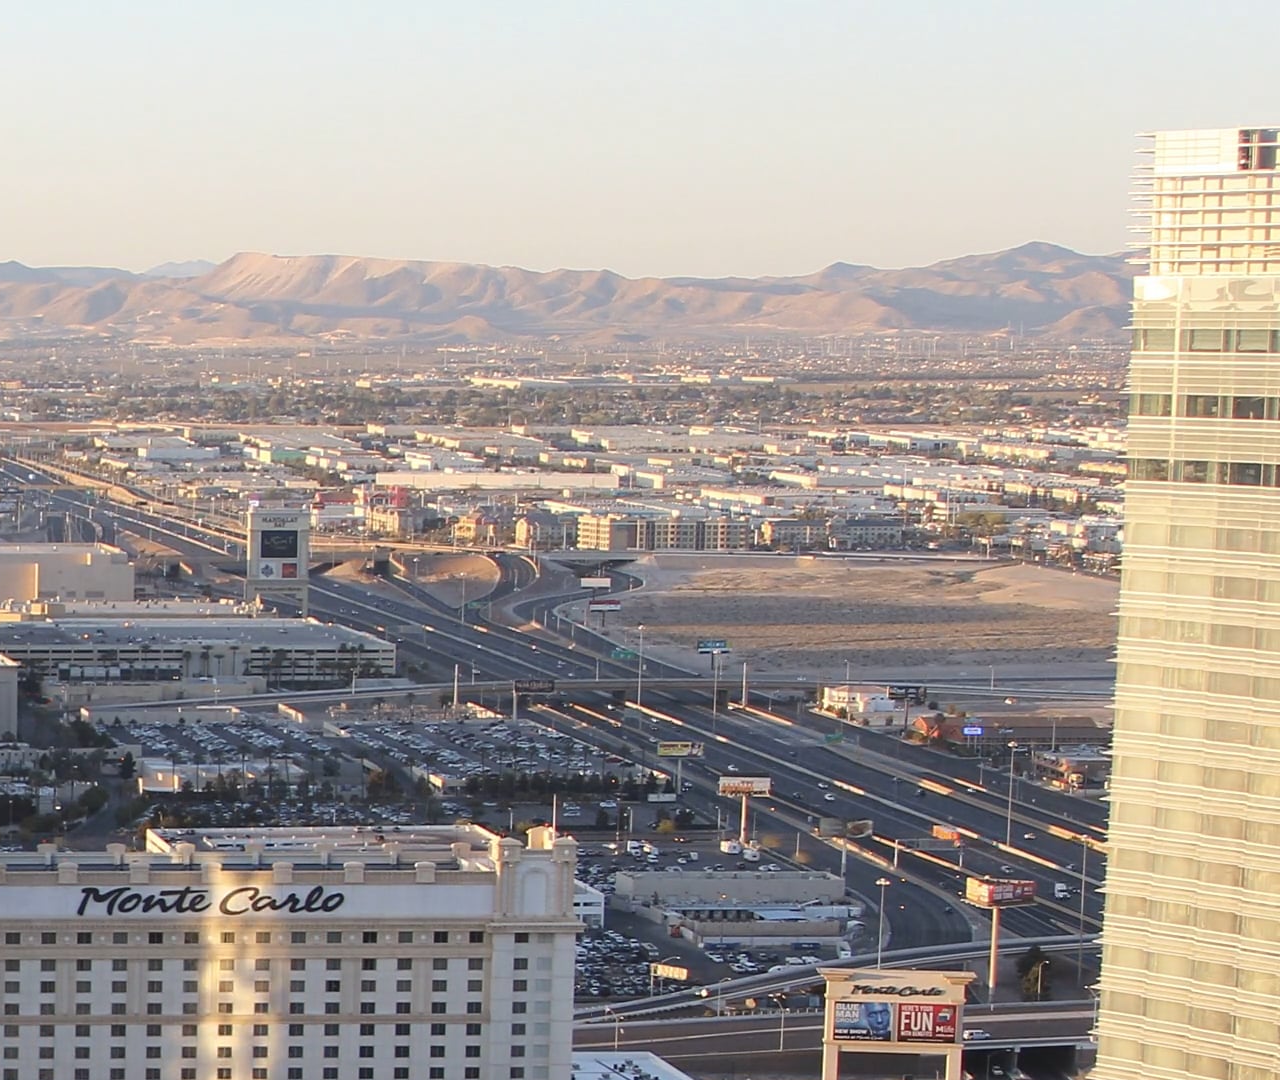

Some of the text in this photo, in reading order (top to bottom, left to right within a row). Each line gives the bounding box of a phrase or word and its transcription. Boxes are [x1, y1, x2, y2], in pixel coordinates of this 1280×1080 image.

[76, 885, 345, 916] Monte Carlo
[851, 985, 946, 997] Monte Carlo
[835, 1010, 860, 1018] MAN
[900, 1011, 934, 1031] FUN
